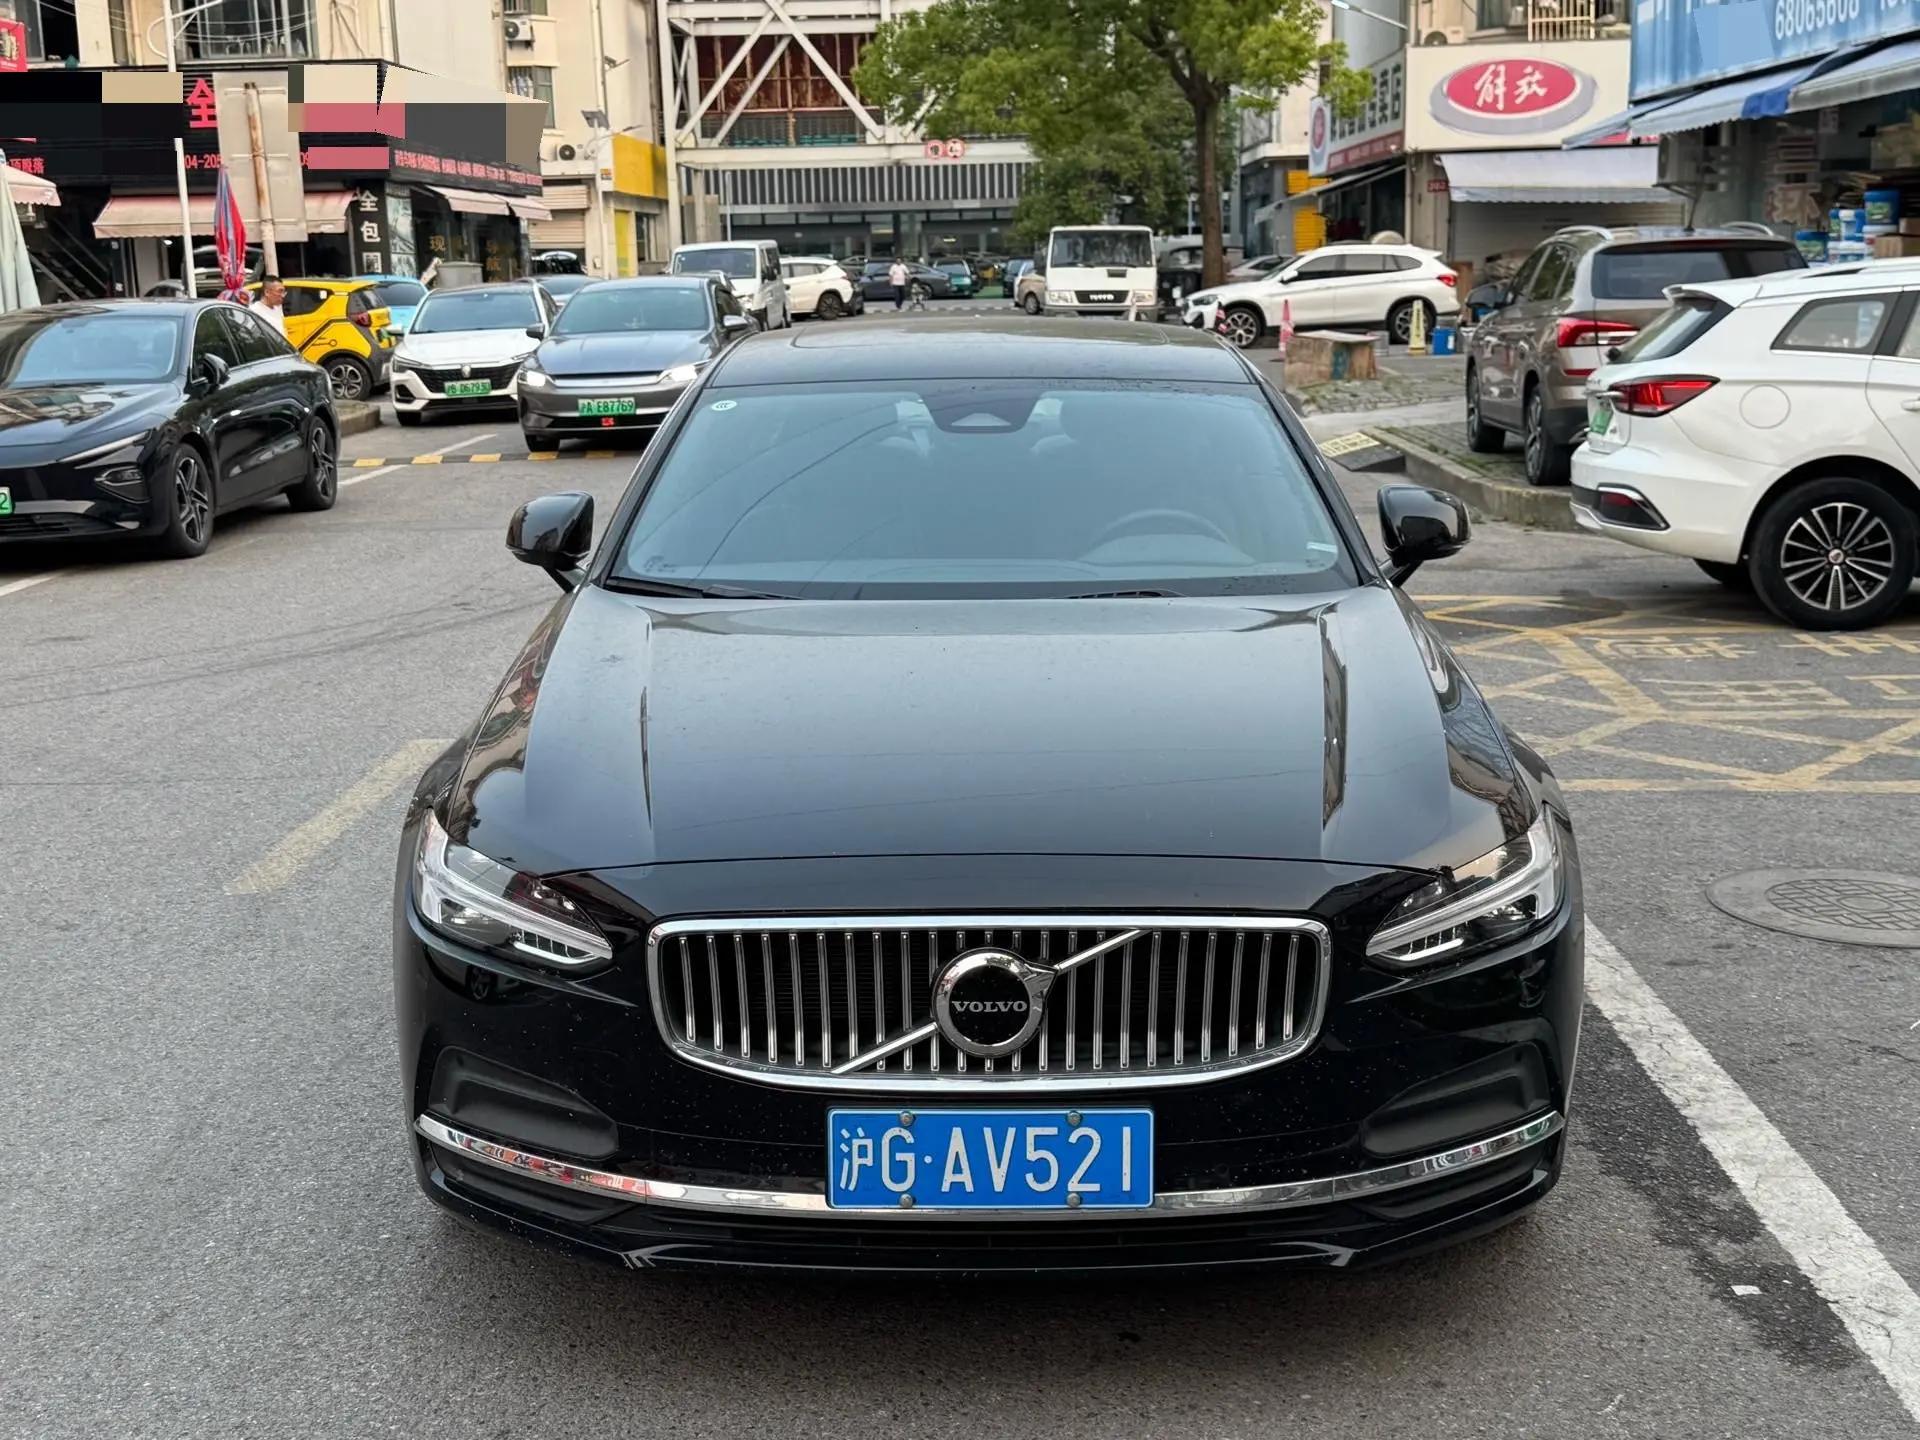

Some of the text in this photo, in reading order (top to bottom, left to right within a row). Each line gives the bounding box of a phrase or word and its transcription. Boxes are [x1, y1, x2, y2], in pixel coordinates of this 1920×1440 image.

[1473, 63, 1548, 112] 解放
[951, 1000, 1028, 1013] VOLVO
[839, 1126, 1132, 1193] 沪G·AV521
